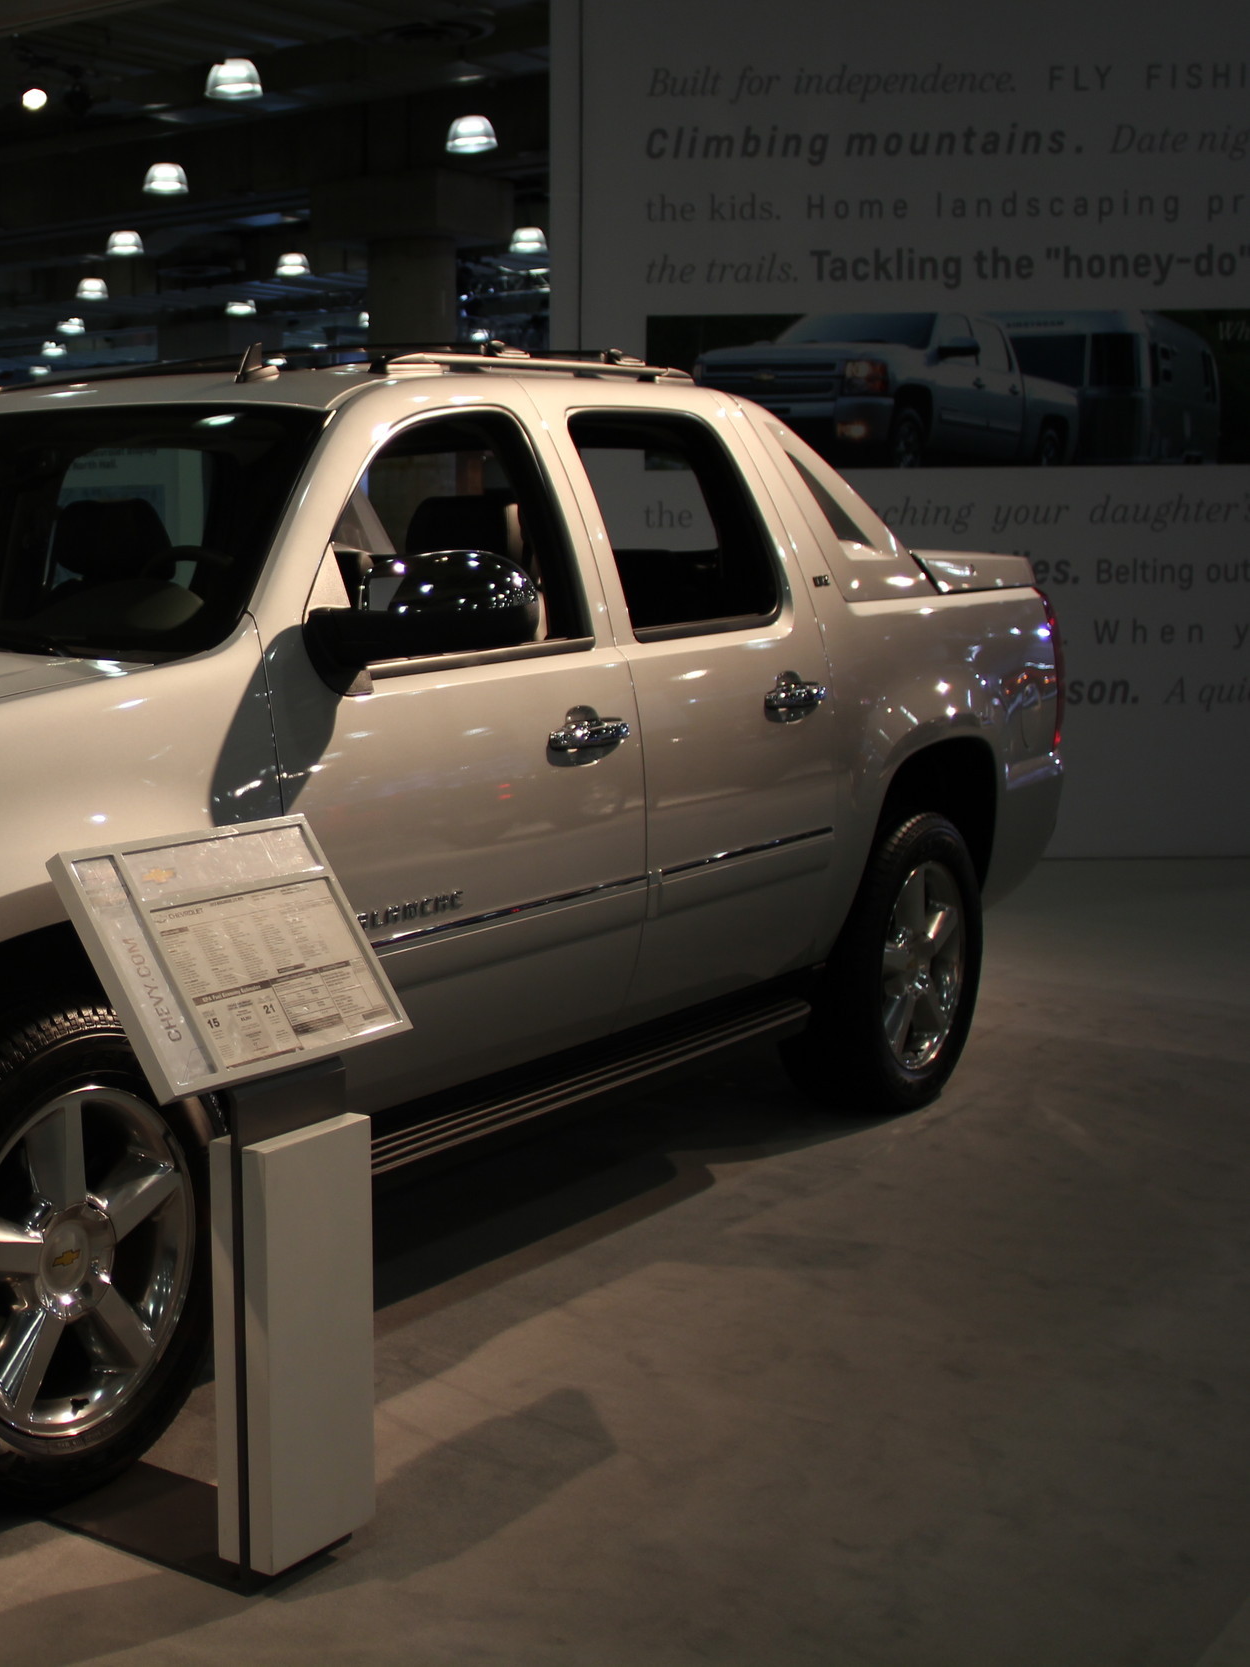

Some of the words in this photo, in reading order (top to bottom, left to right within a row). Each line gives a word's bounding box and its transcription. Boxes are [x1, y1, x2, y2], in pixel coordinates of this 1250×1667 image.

[647, 67, 723, 99] Built
[729, 66, 781, 104] for
[794, 64, 1018, 103] independence.
[1050, 64, 1113, 93] FLY
[1146, 61, 1248, 90] FISHI
[646, 126, 830, 166] Climbing
[845, 123, 1085, 158] mountains.
[1110, 123, 1189, 154] Date
[646, 195, 697, 222] the
[708, 193, 782, 222] kids.
[805, 194, 910, 220] Home
[936, 189, 1181, 224] landscaping
[1207, 194, 1247, 222] pr
[646, 254, 696, 285] the
[705, 254, 800, 285] trails.
[810, 247, 963, 291] Tackling
[974, 247, 1036, 282] the
[644, 502, 694, 529] the
[874, 496, 976, 534] ching
[991, 503, 1070, 534] your
[1095, 557, 1194, 591] Belting
[1206, 560, 1250, 584] out
[1093, 617, 1204, 645] When
[1163, 675, 1187, 704] A
[122, 937, 183, 1043] CHEVY.COM
[207, 1017, 221, 1030] 15
[263, 1003, 276, 1014] 21
